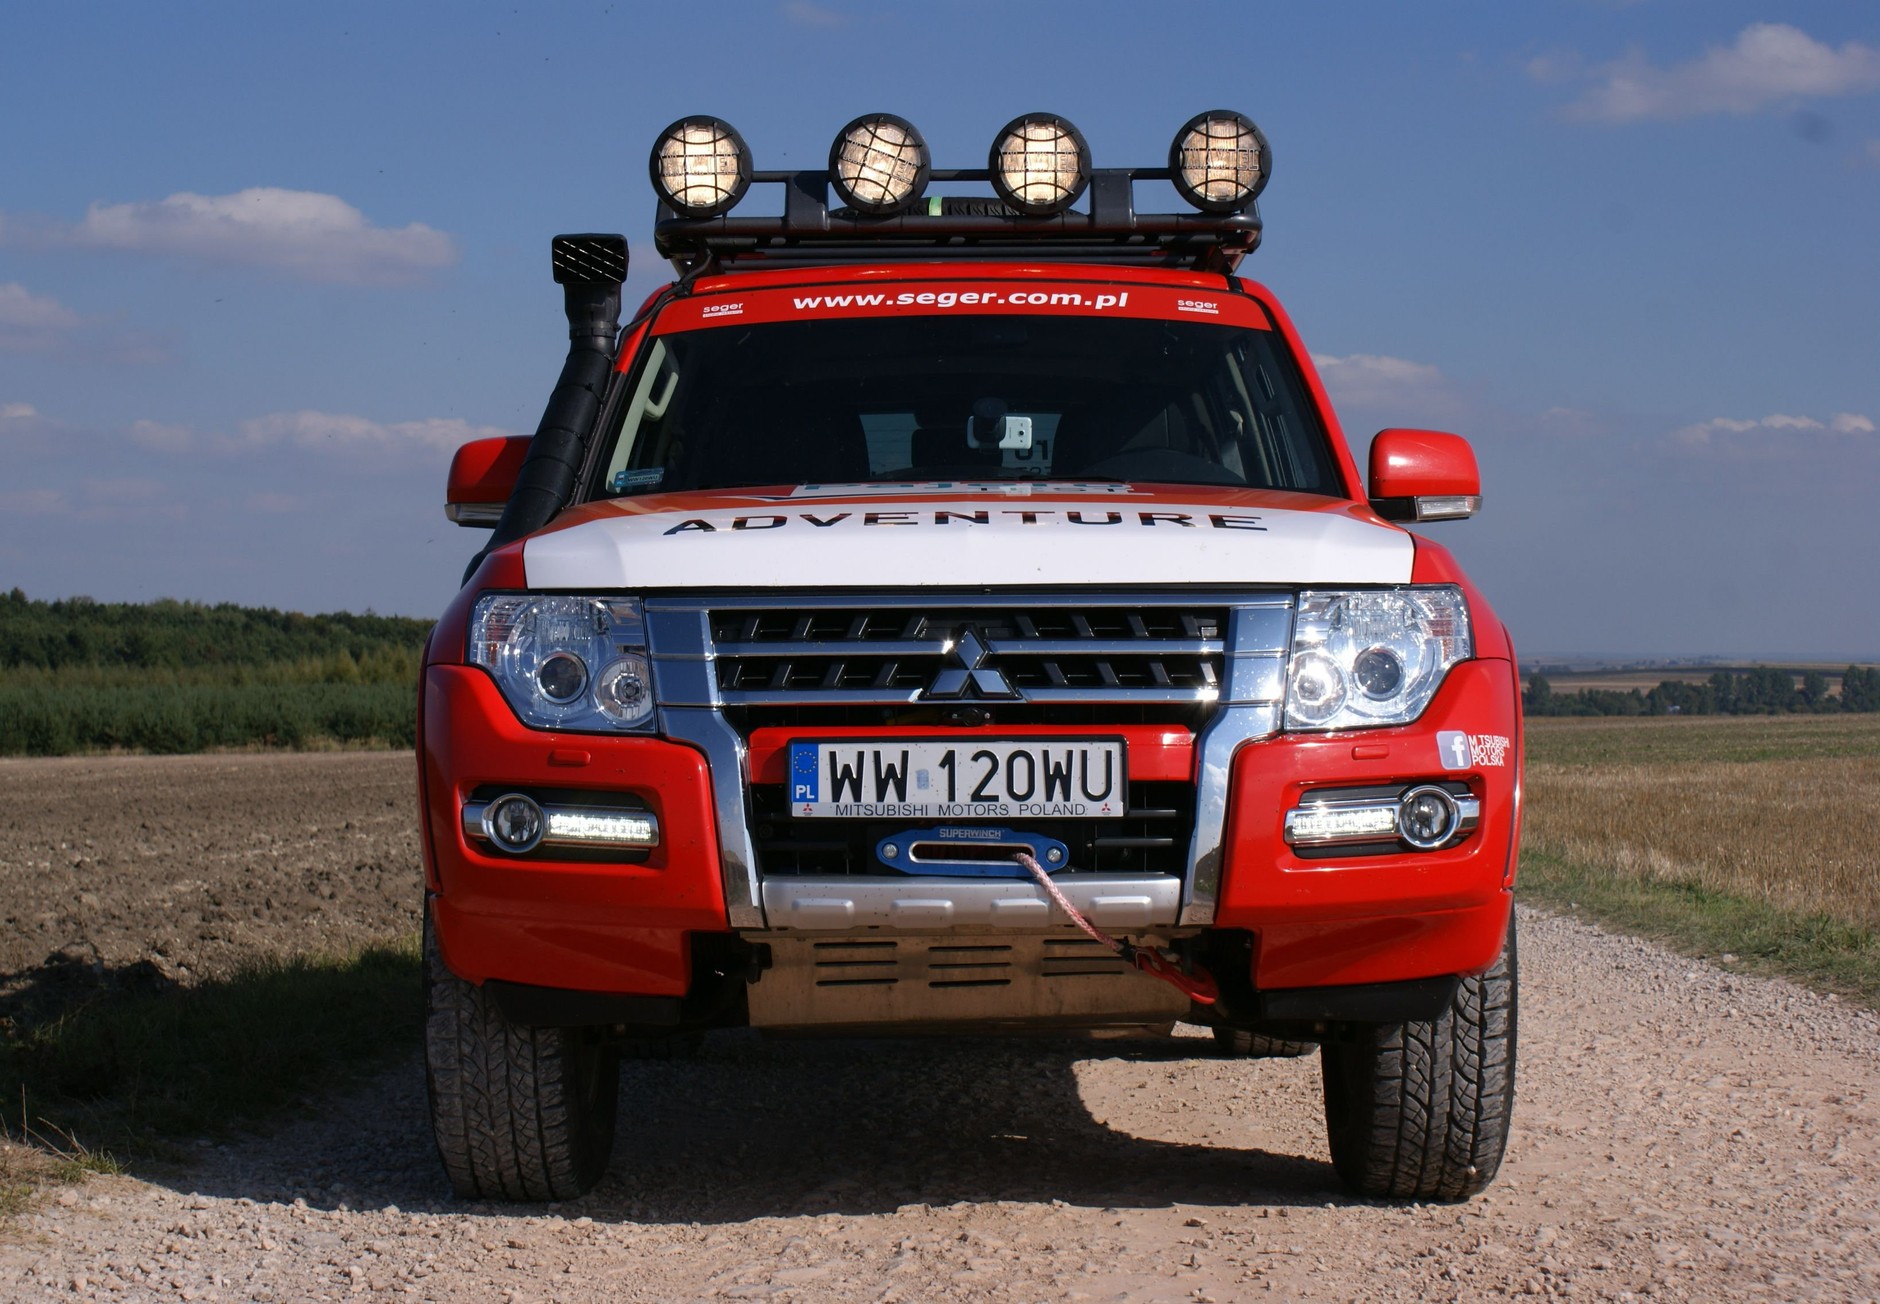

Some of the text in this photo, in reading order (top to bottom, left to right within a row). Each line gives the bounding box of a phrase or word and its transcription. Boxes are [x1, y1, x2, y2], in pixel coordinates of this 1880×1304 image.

[703, 302, 744, 313] seger
[793, 292, 1129, 310] www.seger.com.pl
[1177, 299, 1218, 309] seger
[662, 510, 1268, 536] ADVENTURE
[1472, 755, 1505, 767] POLSKA
[829, 749, 1113, 803] WW 120WU
[795, 784, 815, 799] PL
[835, 803, 1086, 817] MITSUBISHI MOTORS POLAND
[939, 828, 1002, 840] SUPERWINCH
